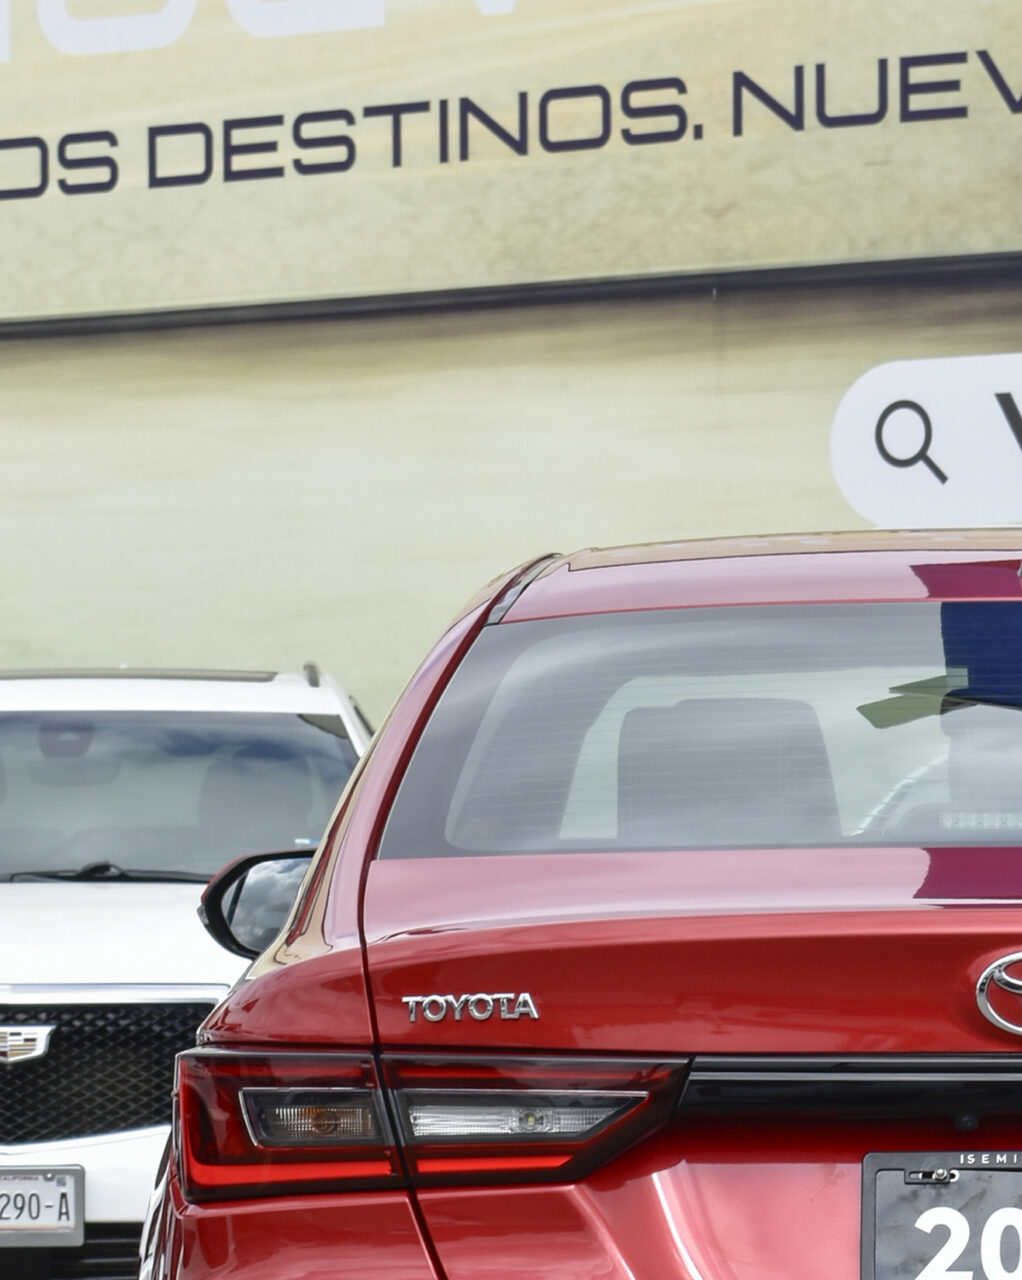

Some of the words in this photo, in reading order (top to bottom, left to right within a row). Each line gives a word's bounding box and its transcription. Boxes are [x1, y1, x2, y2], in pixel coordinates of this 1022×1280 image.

[147, 77, 704, 190] DESTINOS.
[401, 992, 540, 1023] TOYOTA
[0, 1192, 70, 1222] 290-A
